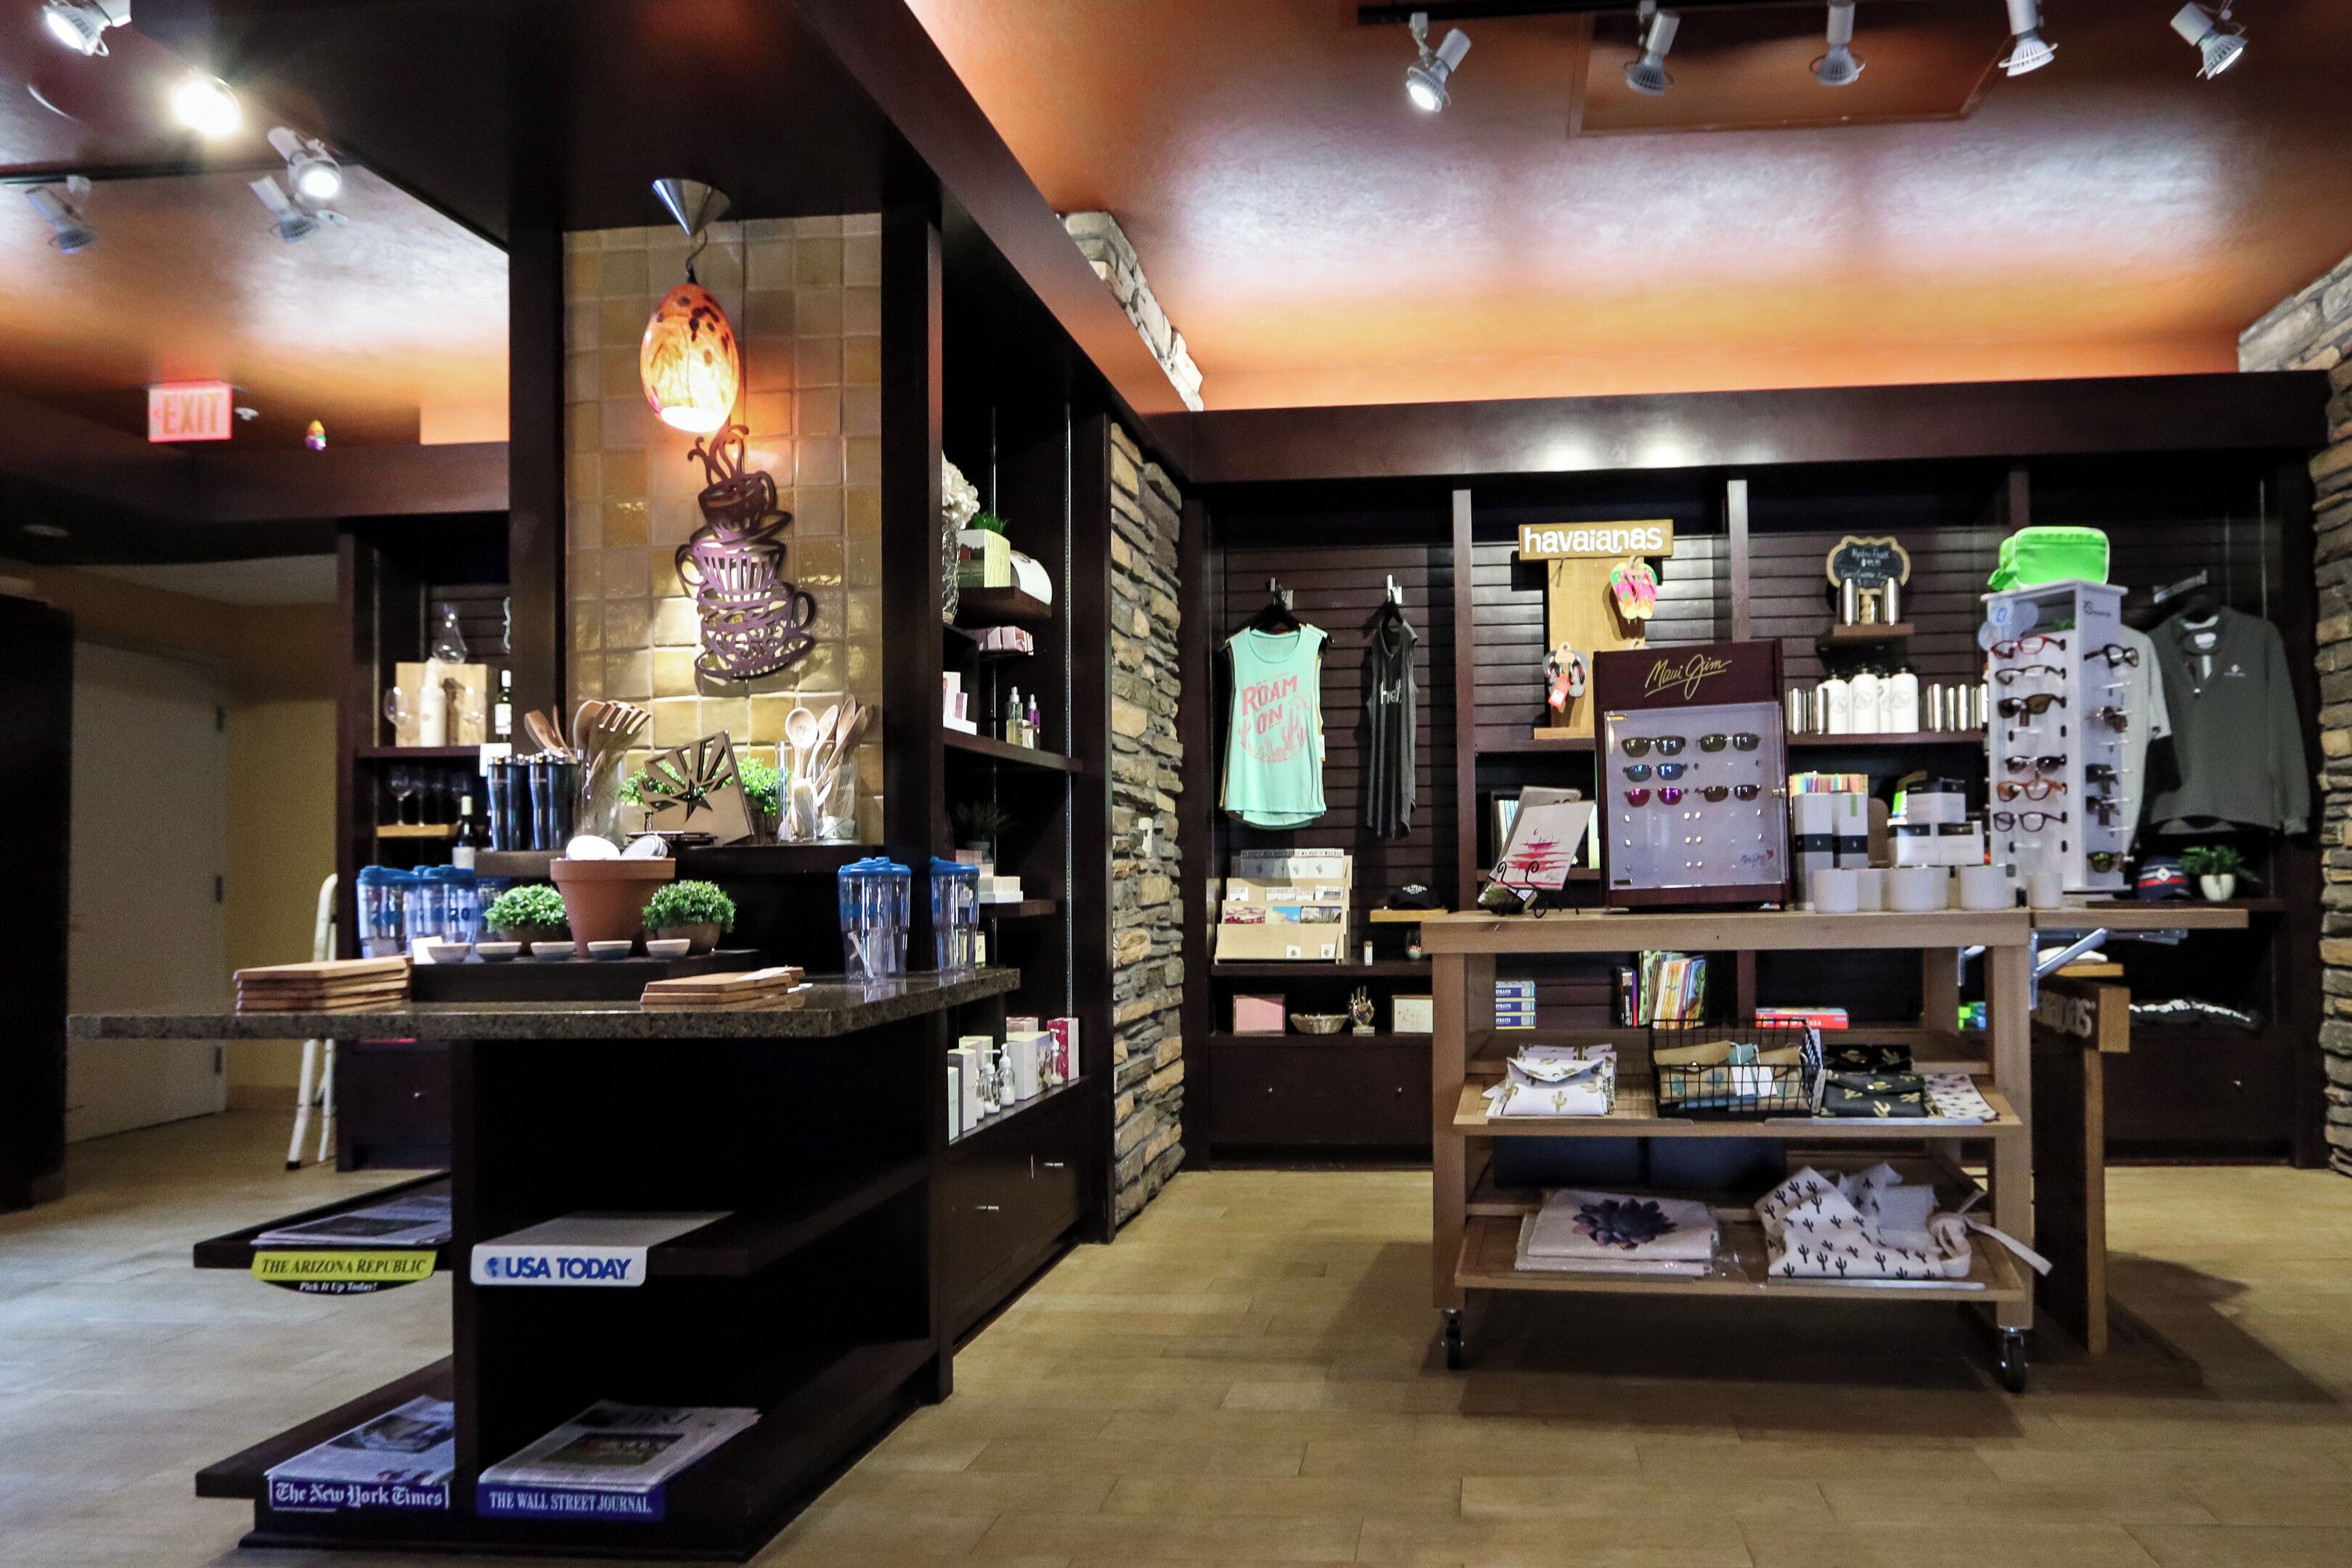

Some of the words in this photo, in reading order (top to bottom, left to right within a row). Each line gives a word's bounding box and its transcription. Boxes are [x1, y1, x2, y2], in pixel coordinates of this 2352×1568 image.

[163, 393, 221, 435] EXIT
[1524, 527, 1664, 553] havaianas
[1644, 658, 1683, 689] Maui
[1685, 653, 1733, 700] Jim
[1242, 675, 1297, 716] ROAM
[1257, 704, 1283, 735] ON
[262, 1258, 290, 1273] THE
[291, 1259, 353, 1274] ARIZONA
[356, 1257, 427, 1273] REPUBLIC
[505, 1257, 552, 1278] USA
[557, 1257, 632, 1279] TODAY
[300, 1282, 318, 1291] Pick
[331, 1282, 345, 1293] Up
[348, 1282, 378, 1292] Today!
[275, 1482, 307, 1503] The
[309, 1483, 345, 1503] New
[347, 1485, 389, 1508] York
[392, 1486, 443, 1506] Times
[489, 1491, 514, 1508] THE
[516, 1493, 548, 1511] WALL
[550, 1493, 596, 1512] STREET
